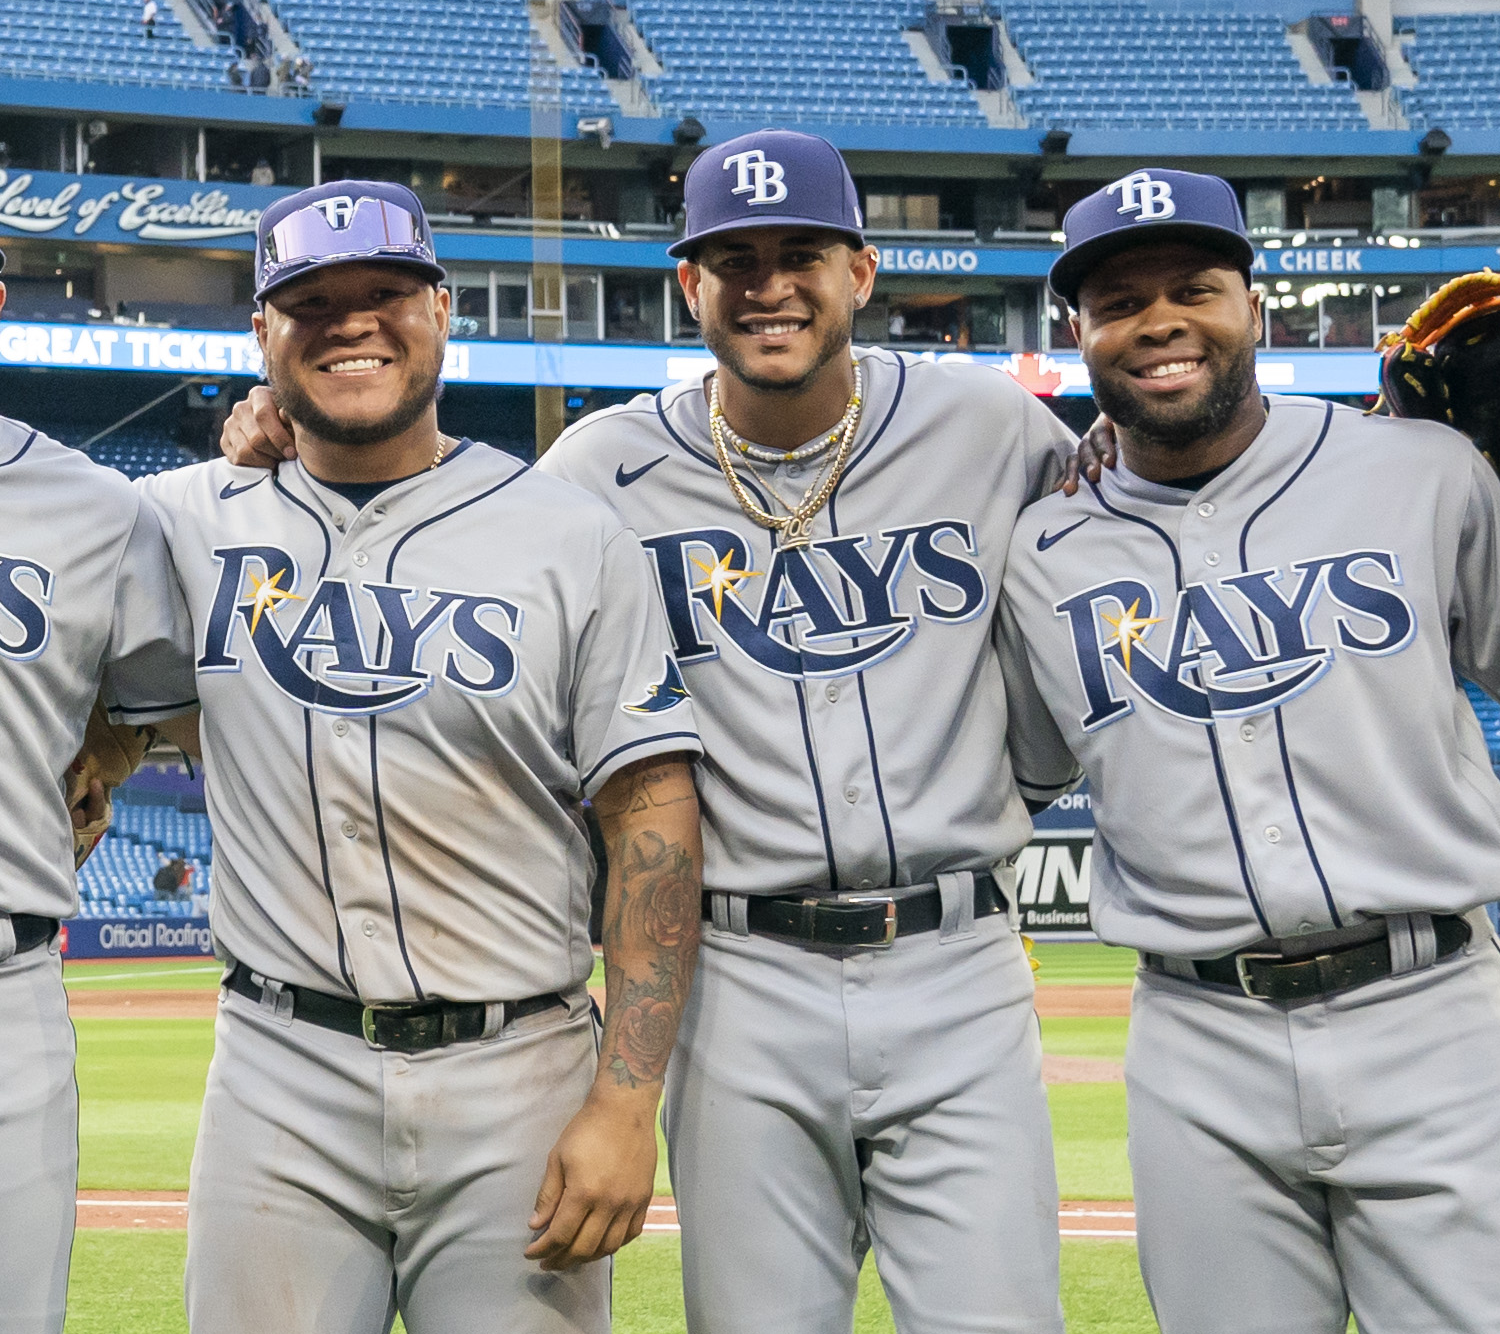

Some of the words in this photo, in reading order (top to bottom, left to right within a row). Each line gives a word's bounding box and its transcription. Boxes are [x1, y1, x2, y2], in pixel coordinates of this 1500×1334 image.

[722, 149, 788, 206] TB
[1106, 171, 1177, 223] TB
[74, 191, 119, 235] of
[118, 182, 260, 240] Excellenc
[1279, 250, 1362, 272] CHEEK
[640, 520, 988, 681] RAYS
[197, 543, 525, 716] RAYS
[1053, 548, 1416, 734] RAYS
[100, 923, 154, 950] Official
[156, 923, 211, 953] Roofing
[1027, 910, 1088, 925] Business
